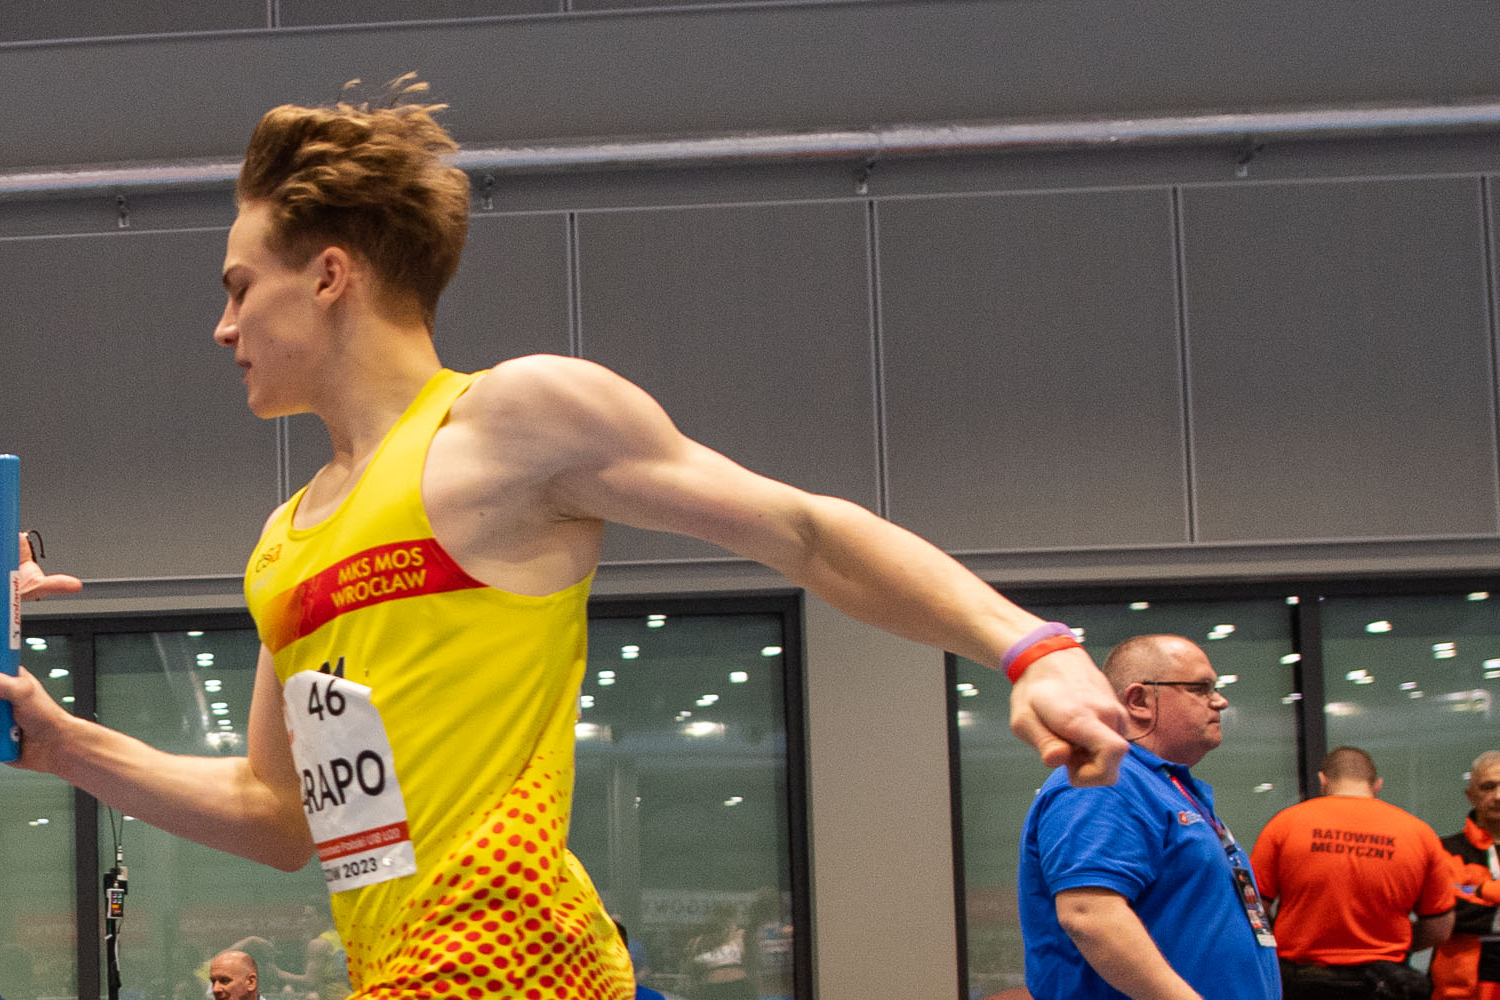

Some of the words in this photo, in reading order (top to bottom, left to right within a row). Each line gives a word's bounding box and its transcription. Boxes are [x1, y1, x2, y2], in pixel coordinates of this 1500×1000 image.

[338, 557, 371, 585] MKS
[374, 547, 425, 573] MOS
[331, 569, 428, 608] WROCŁAW
[307, 679, 346, 721] 46
[302, 749, 386, 815] RAPO
[1310, 842, 1395, 861] MEDYCZNY
[1312, 828, 1396, 848] RATOWNIK
[342, 857, 378, 879] 2023
